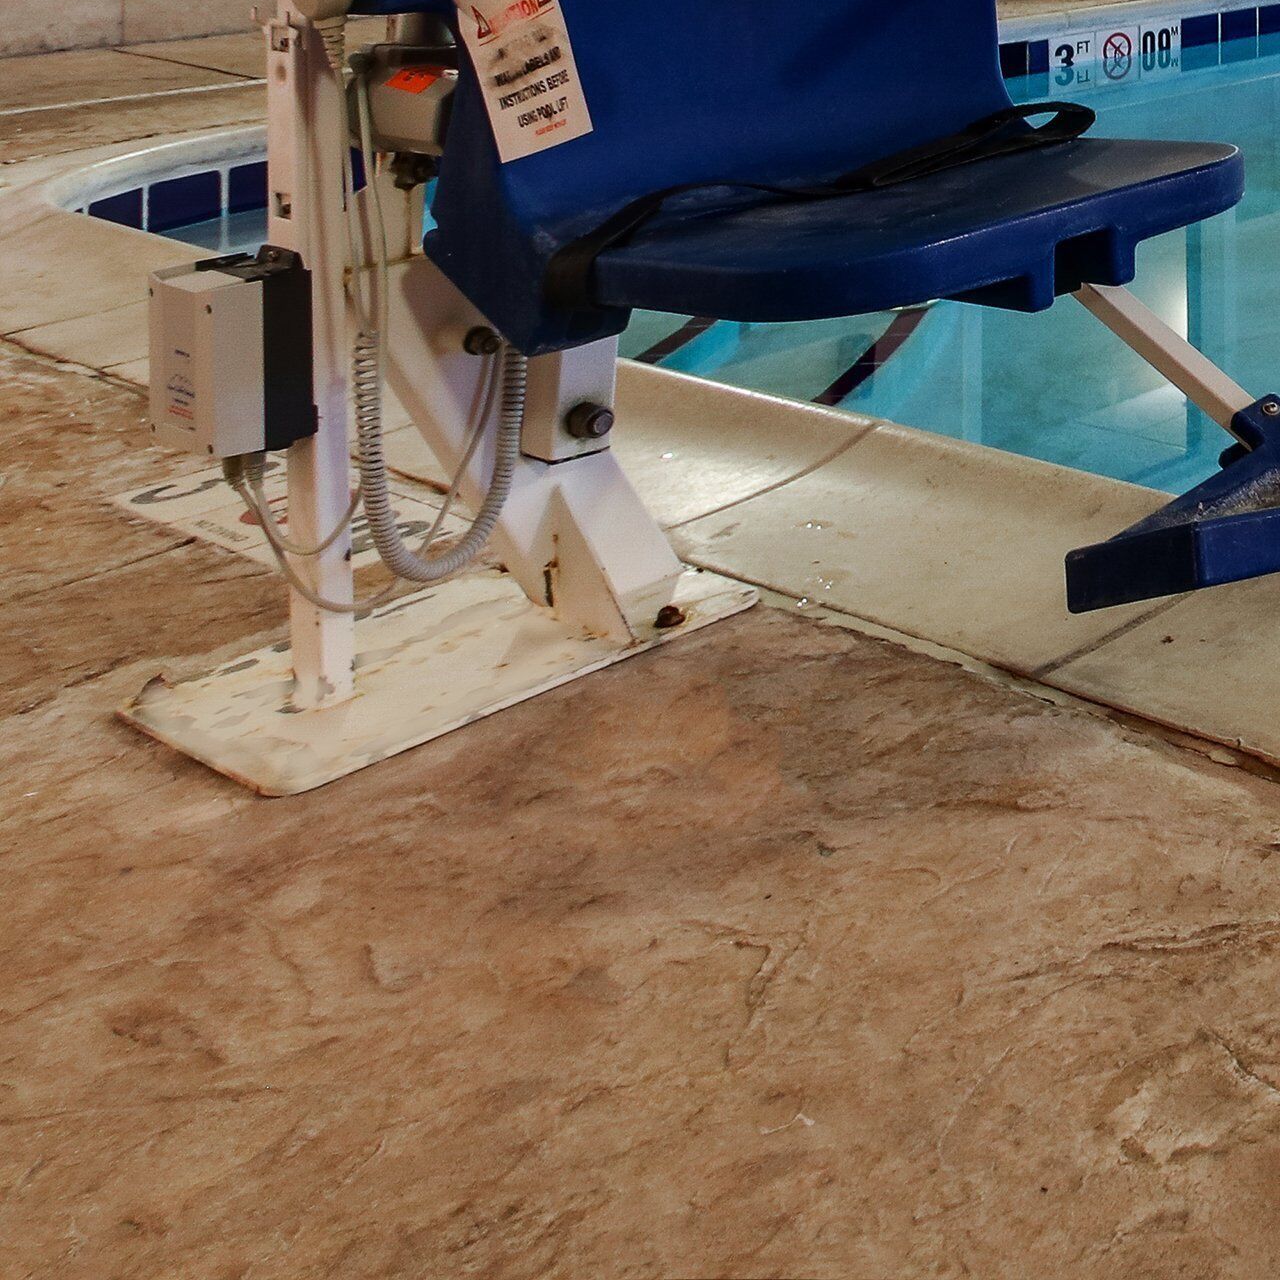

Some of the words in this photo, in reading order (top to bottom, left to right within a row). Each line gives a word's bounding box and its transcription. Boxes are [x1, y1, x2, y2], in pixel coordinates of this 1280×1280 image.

[1055, 44, 1075, 82] 3
[1076, 40, 1090, 54] FT
[499, 80, 547, 110] INSTRUCTIONS
[546, 69, 570, 91] BEFORE
[517, 110, 540, 128] USING
[536, 102, 558, 121] POOL
[556, 96, 570, 114] LIFT
